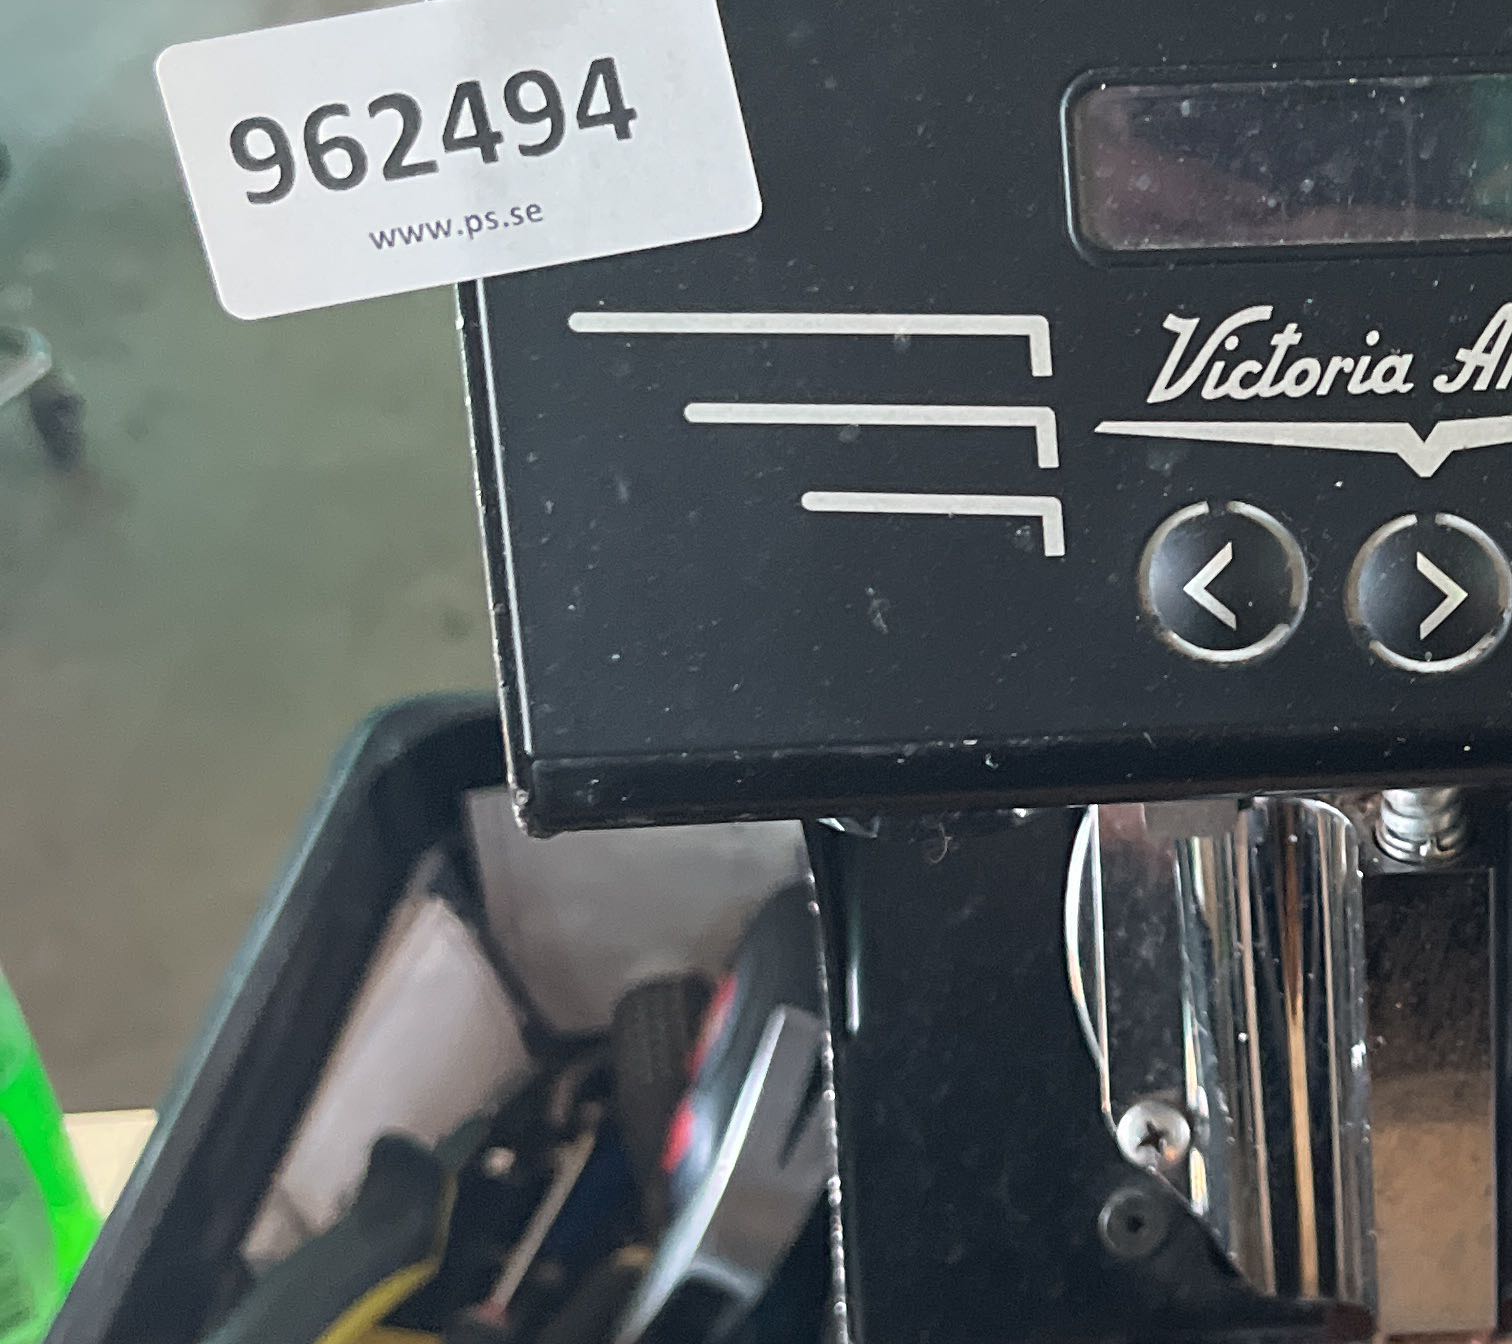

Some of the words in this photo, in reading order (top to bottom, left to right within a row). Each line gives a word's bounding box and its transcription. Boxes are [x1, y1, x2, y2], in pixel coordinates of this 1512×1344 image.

[228, 56, 637, 205] 962494
[367, 200, 544, 250] www.ps.se
[1146, 304, 1414, 404] Victoria
